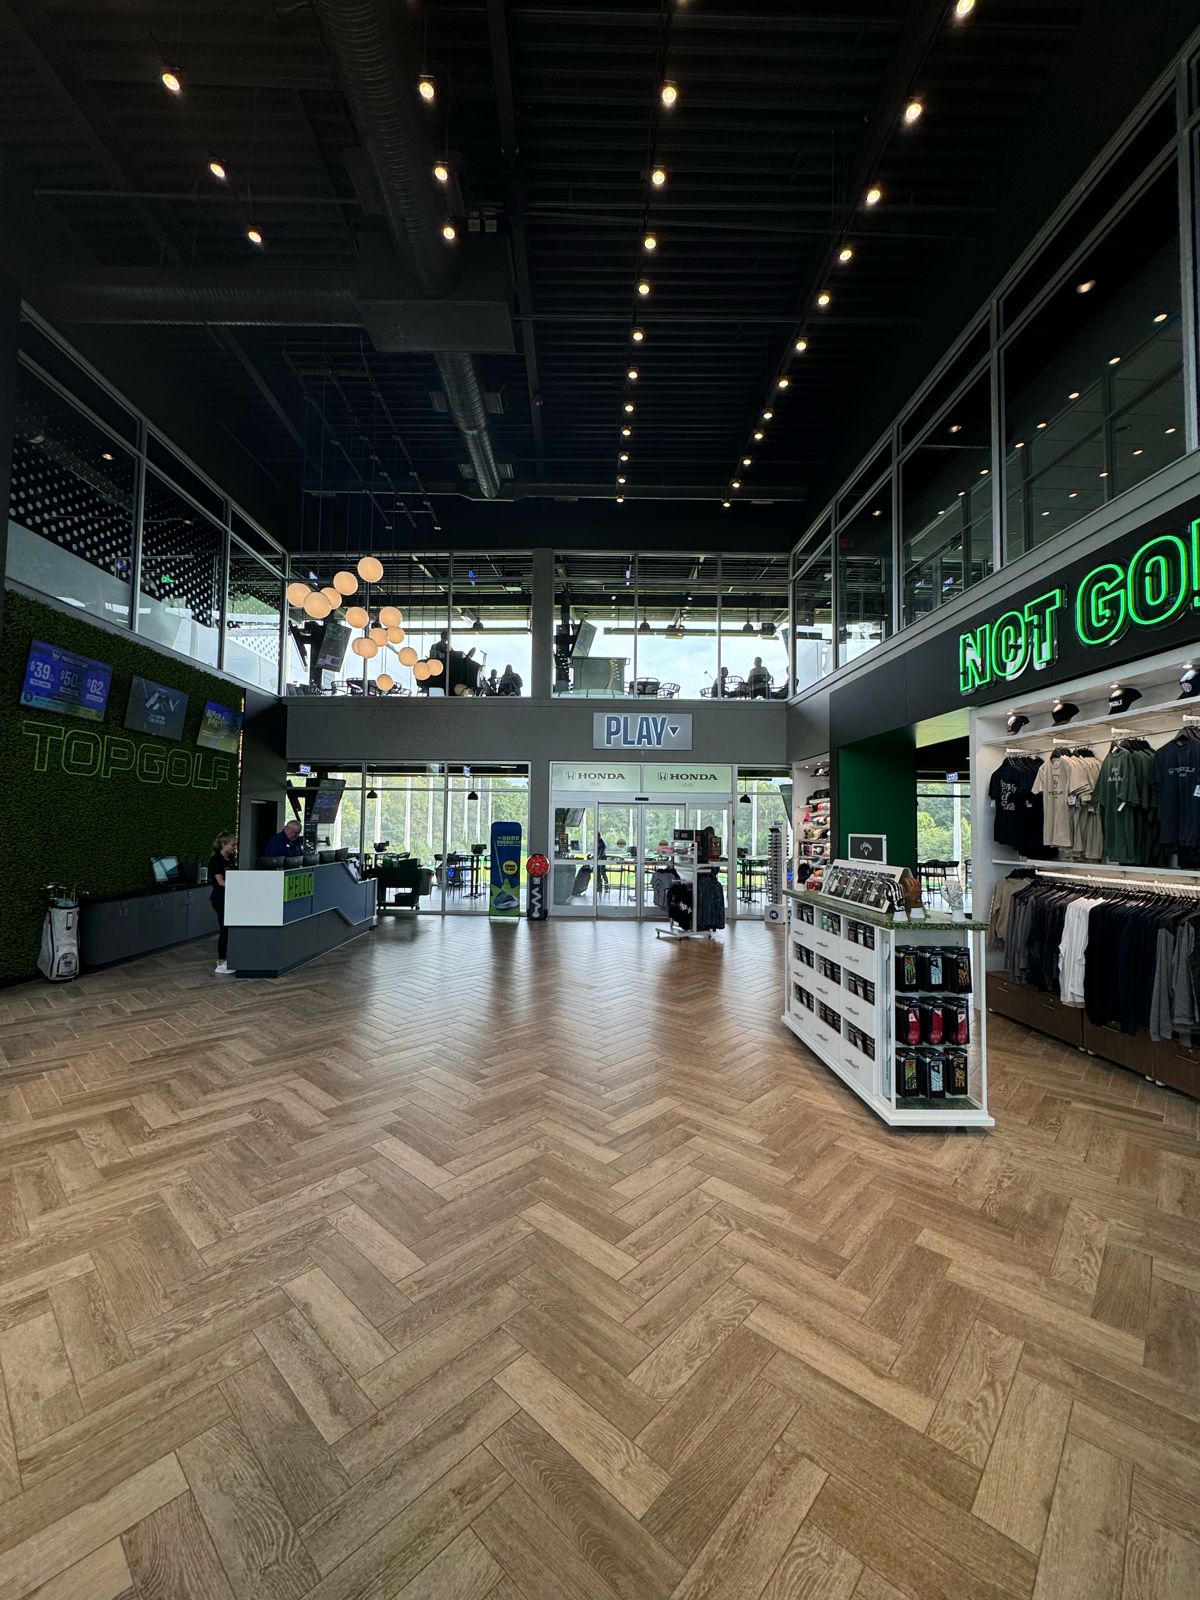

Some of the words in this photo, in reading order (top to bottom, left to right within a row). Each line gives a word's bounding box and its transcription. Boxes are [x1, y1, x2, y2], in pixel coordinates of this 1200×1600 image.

[960, 588, 1061, 692] NOT
[60, 670, 79, 688] $50
[605, 714, 668, 747] PLAY
[22, 720, 231, 789] TOPGOLF
[578, 772, 626, 780] HONDA
[670, 773, 718, 781] HONDA
[288, 873, 313, 900] HELLO
